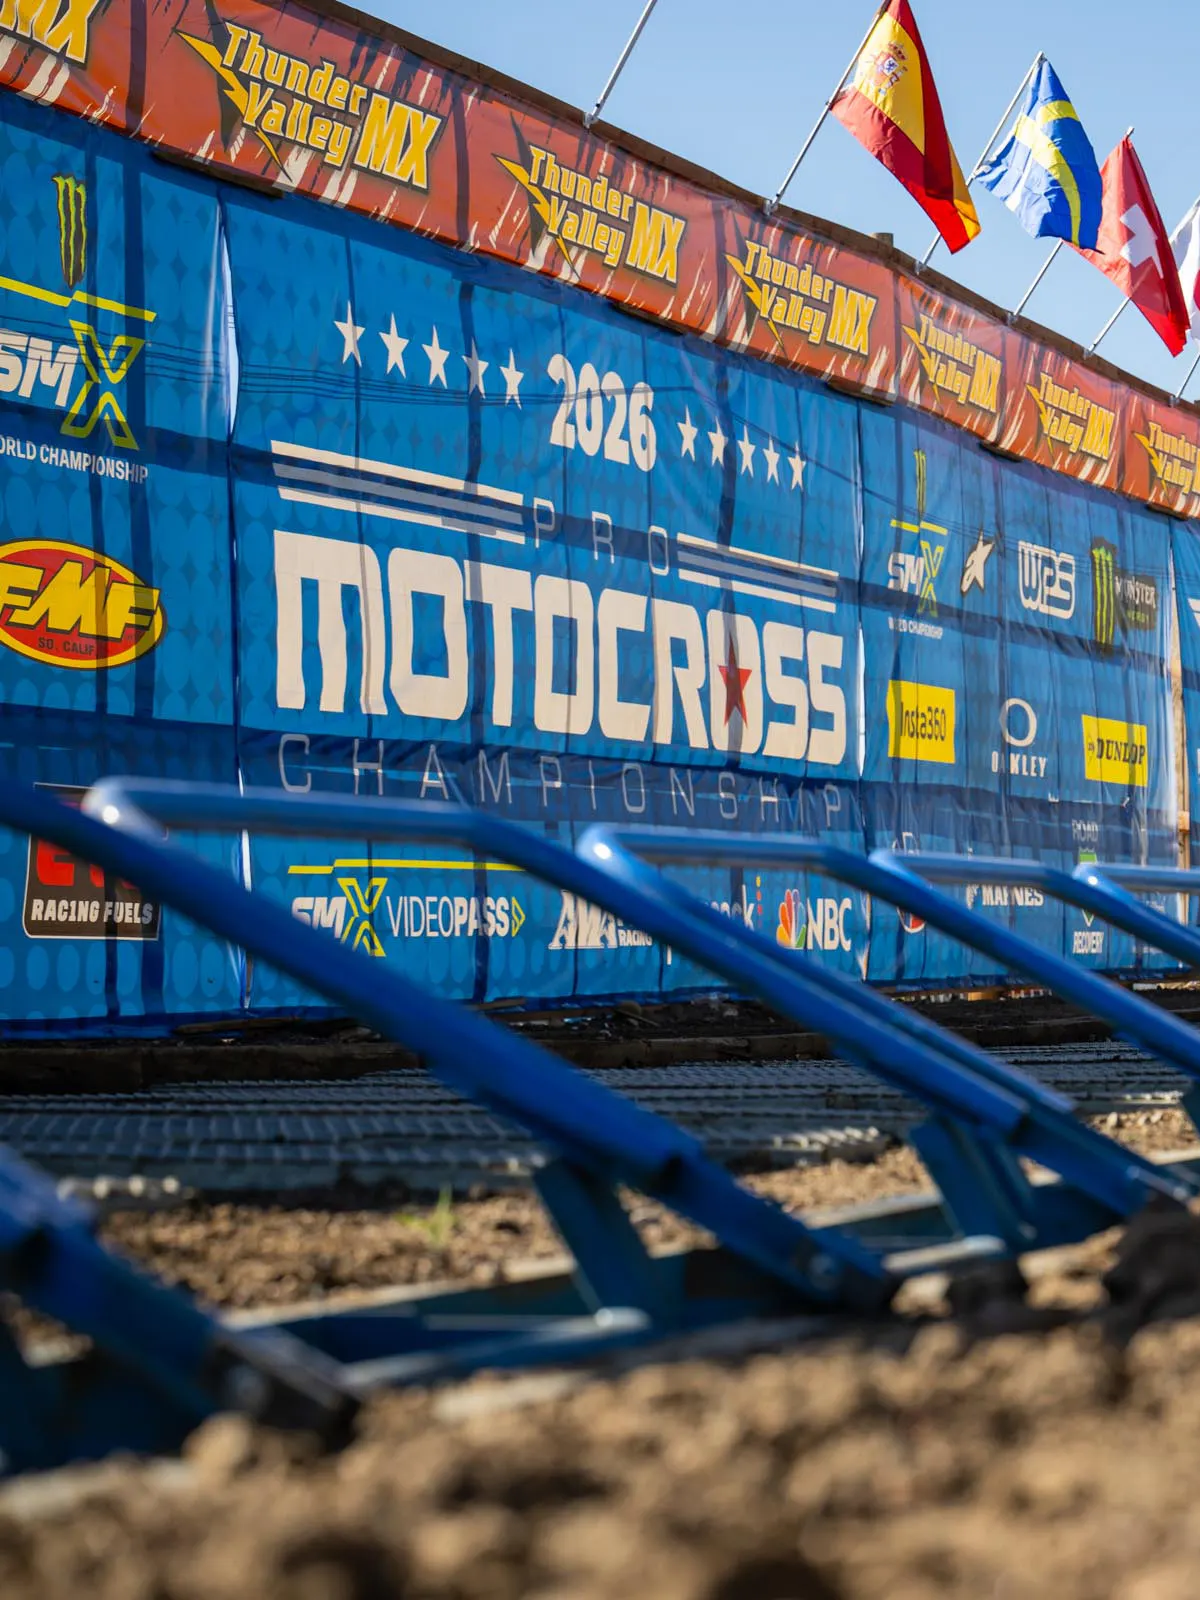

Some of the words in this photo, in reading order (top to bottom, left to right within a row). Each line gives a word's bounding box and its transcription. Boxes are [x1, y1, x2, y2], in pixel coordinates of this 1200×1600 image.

[222, 21, 367, 113] Thunder
[246, 84, 354, 166] Valley
[354, 94, 441, 189] MX
[529, 146, 634, 221] Thunder
[548, 196, 625, 266] Valley
[625, 203, 686, 283] MX
[744, 240, 835, 303] Thunder
[760, 284, 827, 343] Valley
[826, 286, 877, 354] MX
[920, 314, 976, 367] Thunder
[546, 353, 657, 472] 2026
[929, 352, 971, 404] Valley
[969, 351, 1002, 413] MX
[1040, 373, 1091, 419] Thunder
[1046, 407, 1084, 453] Valley
[1081, 404, 1115, 460] MX
[40, 444, 149, 485] CHAMPIONSHIP
[1157, 452, 1193, 494] Valley
[533, 496, 670, 577] PRO
[0, 561, 161, 641] FMF
[274, 530, 847, 765] MOTOCROSS
[901, 702, 946, 742] Insta360
[1096, 737, 1146, 765] DUNLOP
[279, 733, 841, 828] CHAMPIONSHIP
[31, 899, 100, 922] RACING
[103, 902, 153, 924] FUELS
[386, 896, 510, 938] VIDEOPASS
[806, 898, 852, 952] NBC
